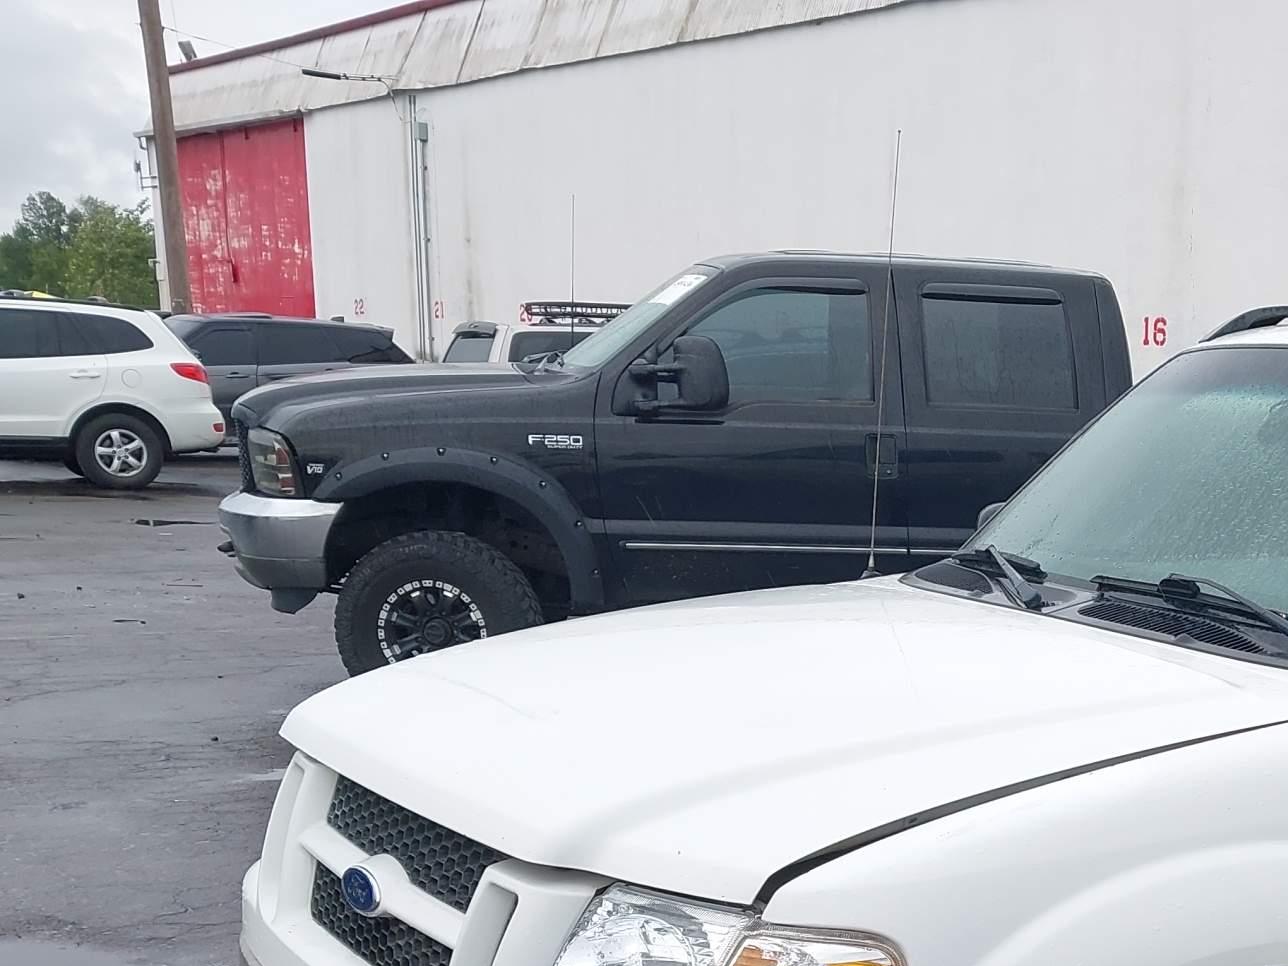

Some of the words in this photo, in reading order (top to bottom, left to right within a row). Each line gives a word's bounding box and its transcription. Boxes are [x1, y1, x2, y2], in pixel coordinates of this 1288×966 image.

[354, 299, 364, 315] 22
[434, 300, 445, 319] 21
[1143, 316, 1167, 346] 16
